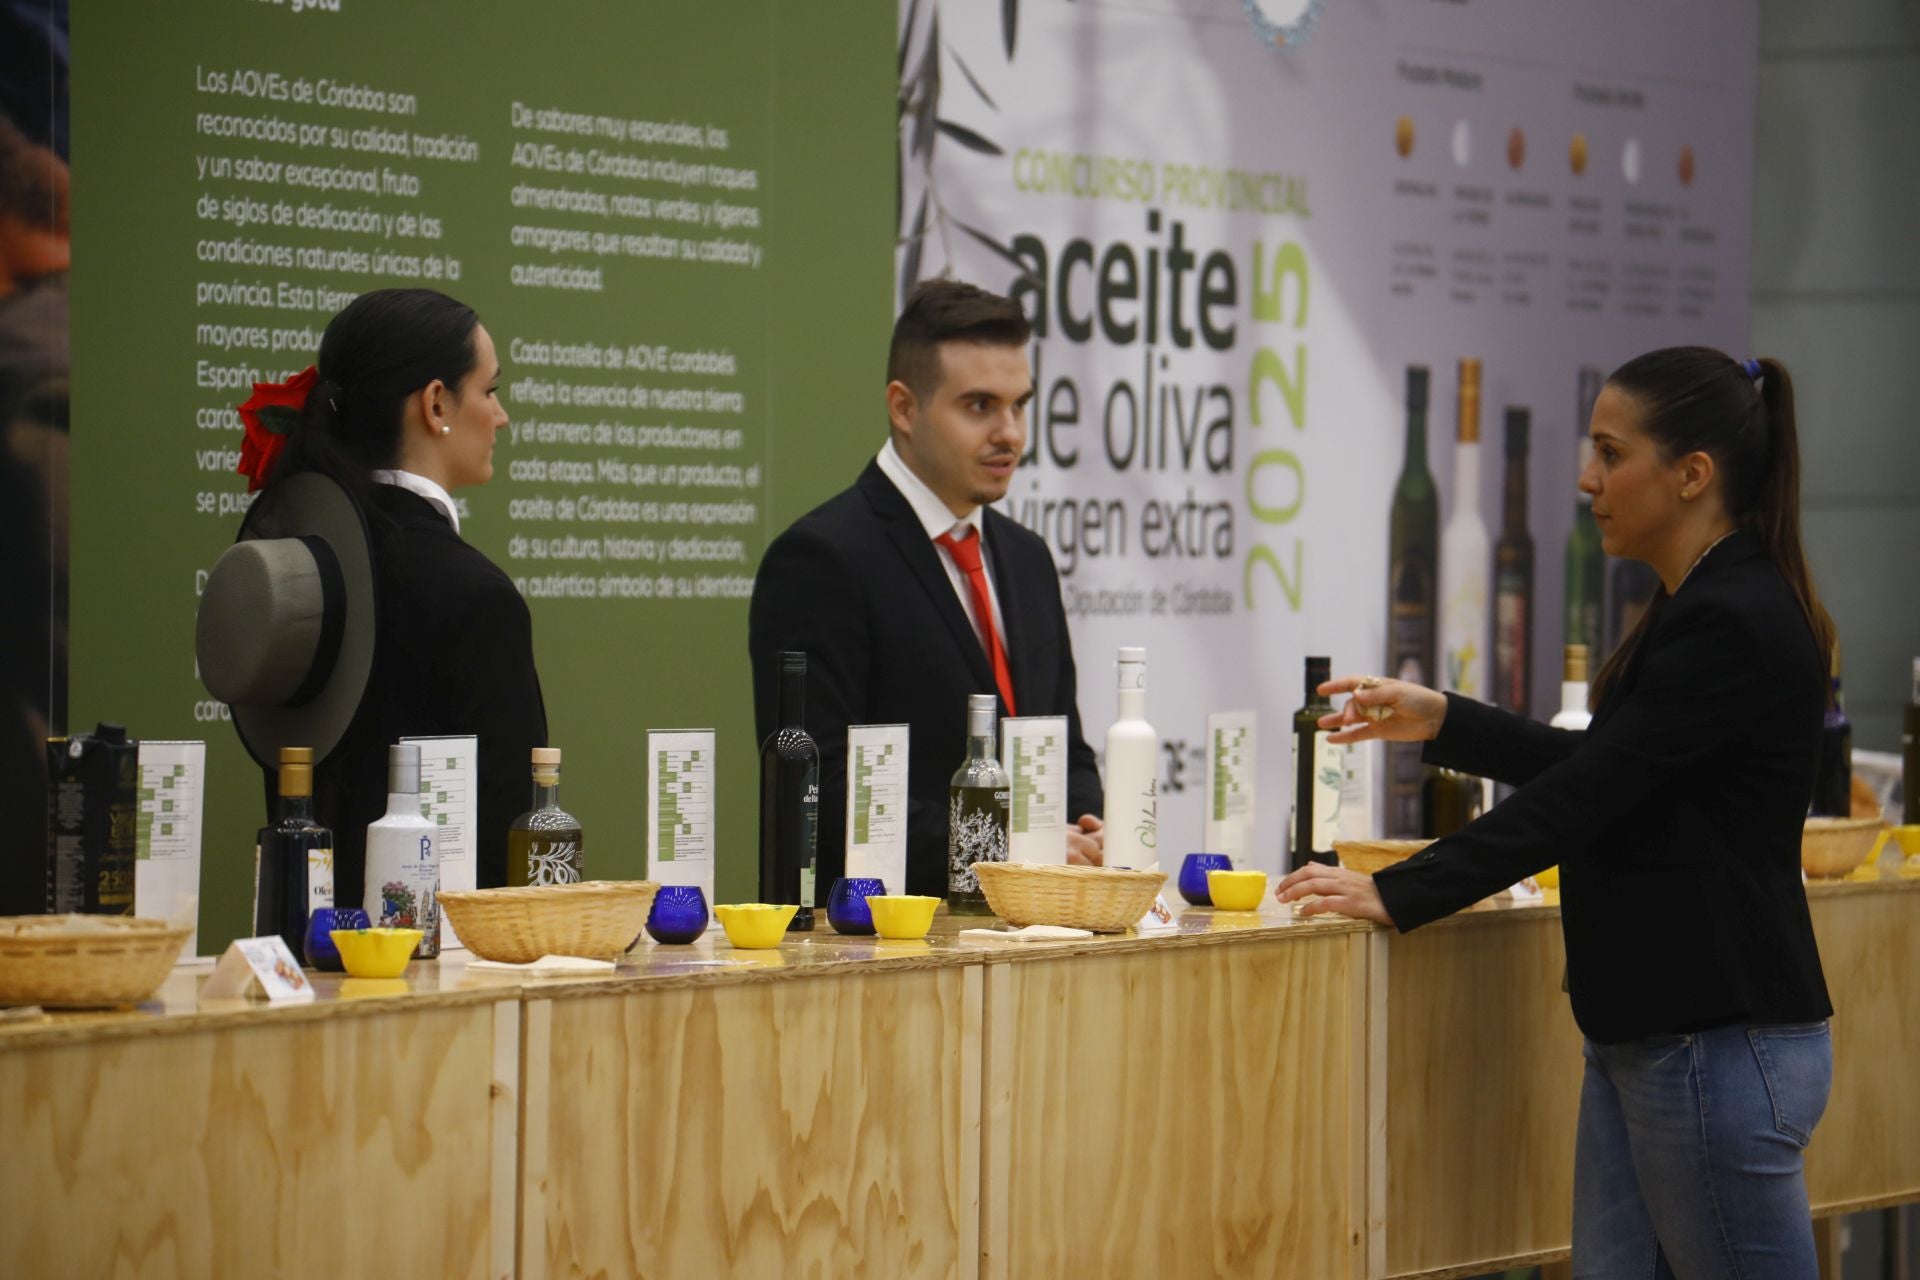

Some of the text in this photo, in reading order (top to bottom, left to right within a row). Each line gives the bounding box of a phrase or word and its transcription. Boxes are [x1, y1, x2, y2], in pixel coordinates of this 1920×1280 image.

[197, 65, 227, 93] Los
[231, 70, 288, 100] AOVEs
[292, 76, 312, 103] de
[316, 79, 384, 111] Córdoba
[197, 112, 295, 143] reconocidos
[300, 124, 327, 149] por
[331, 127, 348, 147] su
[413, 135, 478, 161] tradición
[210, 158, 231, 178] un
[235, 156, 281, 182] sabor
[382, 168, 419, 196] fruto
[1014, 147, 1313, 219] CONCURSO PROVINCIAL
[197, 193, 218, 219] de
[223, 196, 268, 226] siglos
[272, 201, 292, 224] de
[296, 203, 379, 229] dedicación
[397, 214, 417, 236] de
[419, 214, 442, 238] las
[197, 238, 461, 280] condiciones naturales únicas de la
[1010, 209, 1238, 351] aceite
[278, 283, 313, 309] Esta
[317, 285, 360, 311] tierr
[197, 324, 268, 352] mayores
[197, 402, 242, 428] carác
[1104, 350, 1235, 474] oliva
[1244, 239, 1310, 612] 2025
[196, 494, 215, 512] se
[1008, 481, 1234, 577] virgen extra
[694, 574, 754, 598] identida
